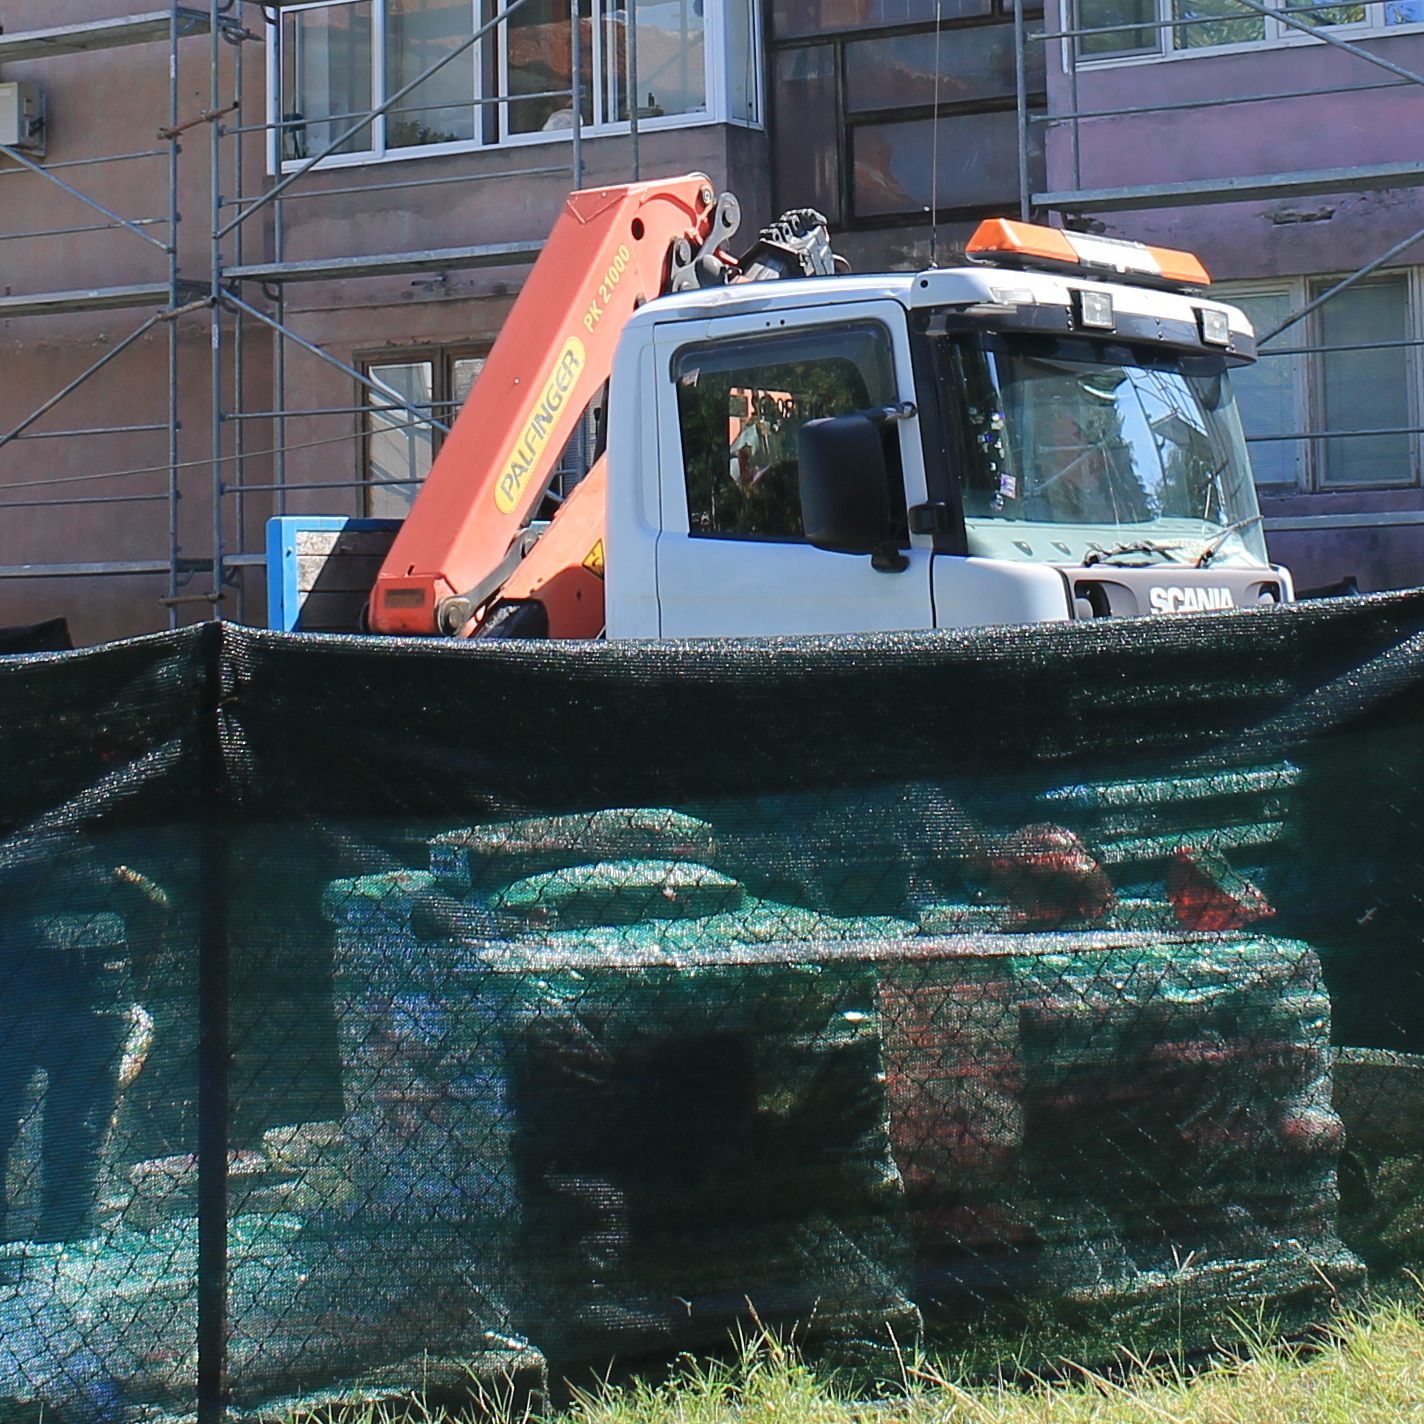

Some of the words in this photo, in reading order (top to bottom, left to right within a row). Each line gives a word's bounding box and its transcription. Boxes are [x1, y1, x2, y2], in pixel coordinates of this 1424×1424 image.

[499, 349, 580, 503] PALFINGER
[582, 299, 603, 333] PK
[598, 244, 631, 304] 21000
[1149, 587, 1235, 614] SCANIA
